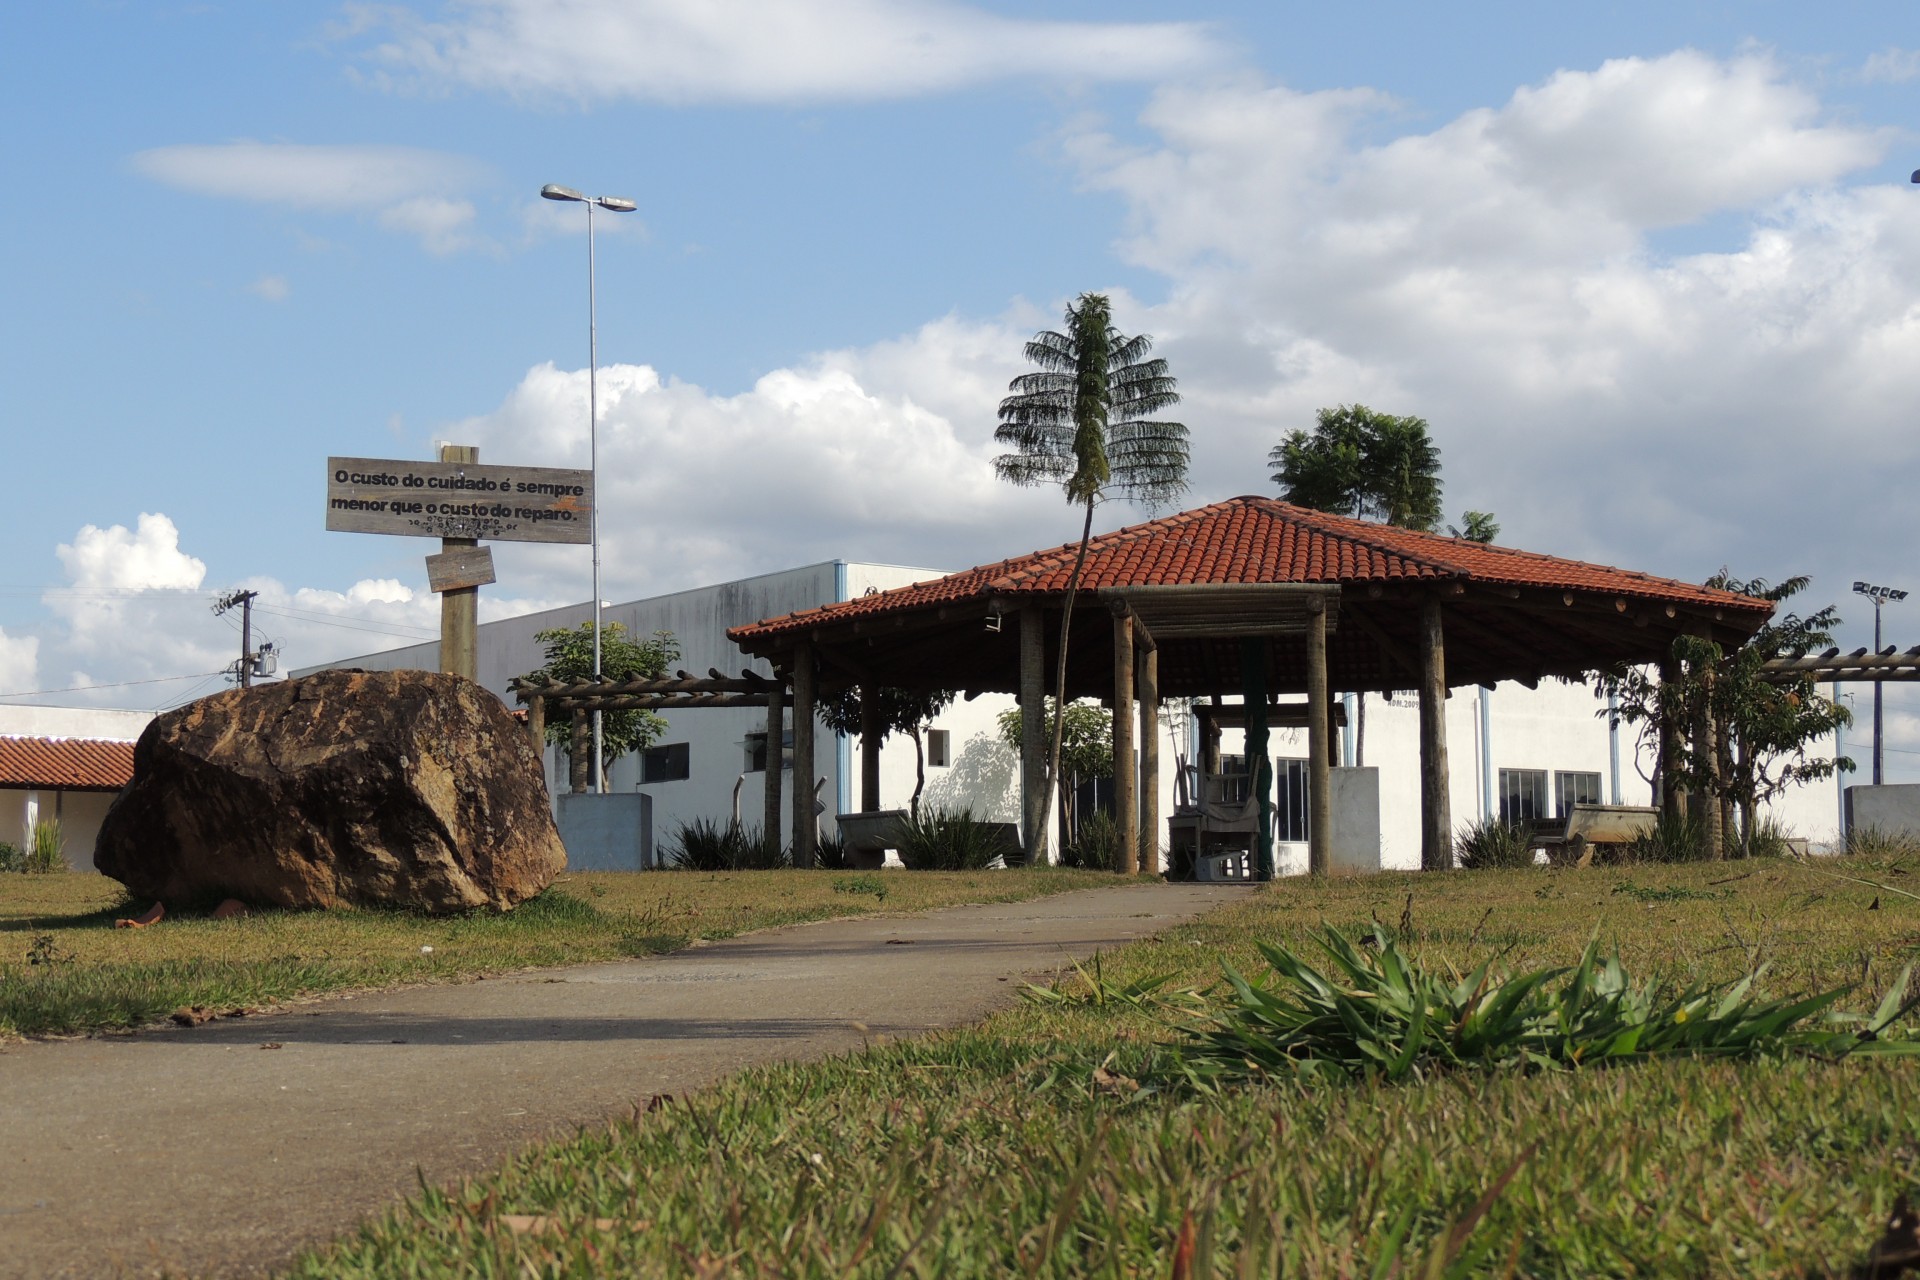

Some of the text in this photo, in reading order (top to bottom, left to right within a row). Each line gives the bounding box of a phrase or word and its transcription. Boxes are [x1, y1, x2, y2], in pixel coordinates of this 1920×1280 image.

[335, 469, 585, 498] O custo do cuidado é sempre
[331, 497, 578, 524] menor que o custo do reparo.
[1387, 699, 1420, 710] ADM.2009
